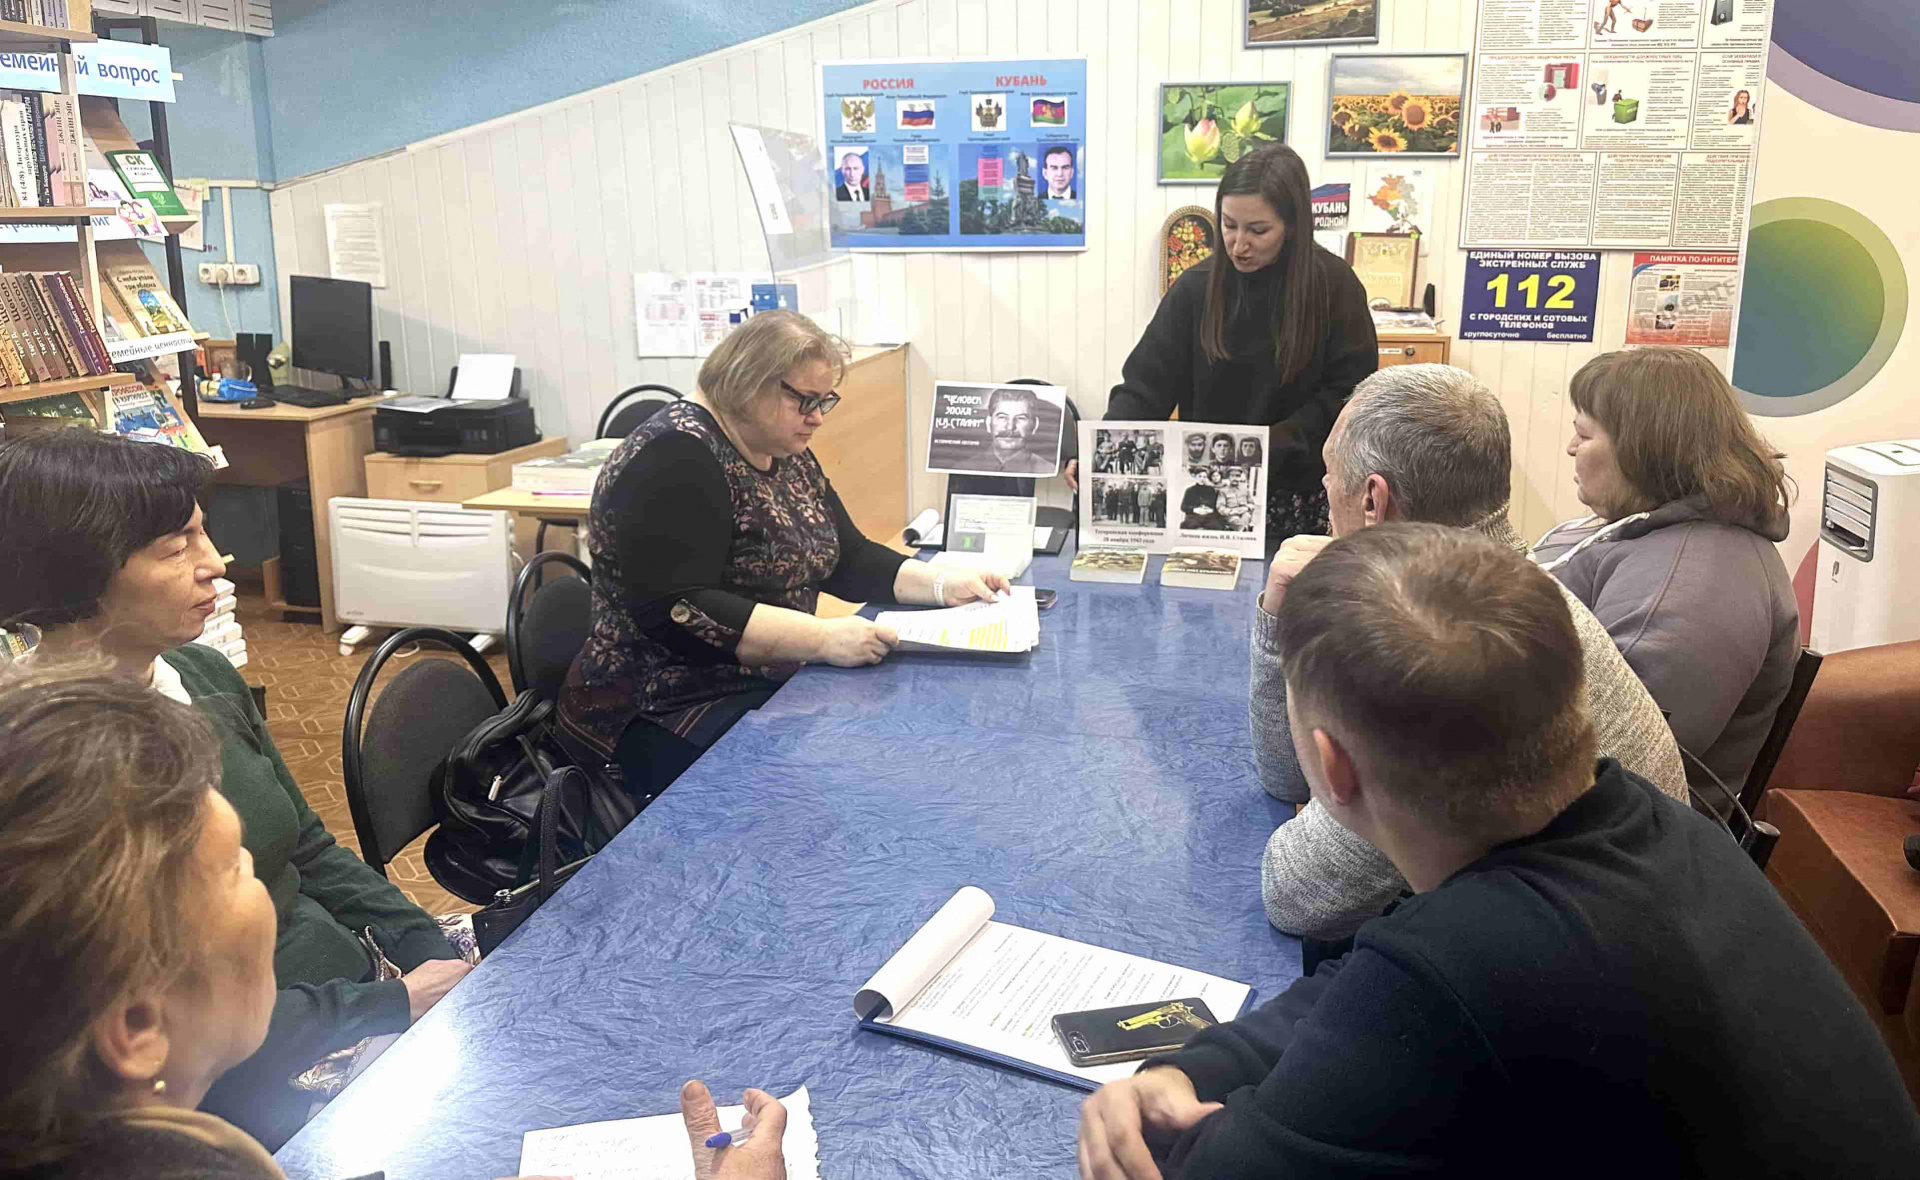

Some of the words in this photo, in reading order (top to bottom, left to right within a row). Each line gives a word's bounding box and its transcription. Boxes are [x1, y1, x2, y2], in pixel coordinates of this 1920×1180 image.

[98, 63, 160, 86] вопрос
[995, 75, 1047, 88] КУБАНЬ
[863, 79, 914, 89] РОССИЯ
[33, 96, 41, 127] воронов
[65, 101, 73, 117] ЭЙР
[67, 117, 77, 146] ДЖЕЙН
[125, 155, 145, 165] СК
[1312, 202, 1347, 214] КУБАНЬ
[1470, 251, 1514, 260] ЕДИНЫЙ
[1650, 255, 1687, 263] ПАМЯТКА
[1479, 260, 1547, 268] ЭКСТРЕННЫХ
[1551, 261, 1586, 269] СЛУЖБ
[55, 276, 75, 310] королевы
[66, 276, 86, 309] королевы
[1487, 273, 1576, 309] 112
[0, 281, 22, 322] Щегол
[11, 280, 33, 321] Щегол
[70, 309, 86, 334] Гамбит
[81, 309, 97, 333] Гамбит
[1478, 313, 1531, 322] ГОРОДСКИХ
[1499, 321, 1554, 329] ТЕЛЕФОНОВ
[154, 337, 192, 353] ценности
